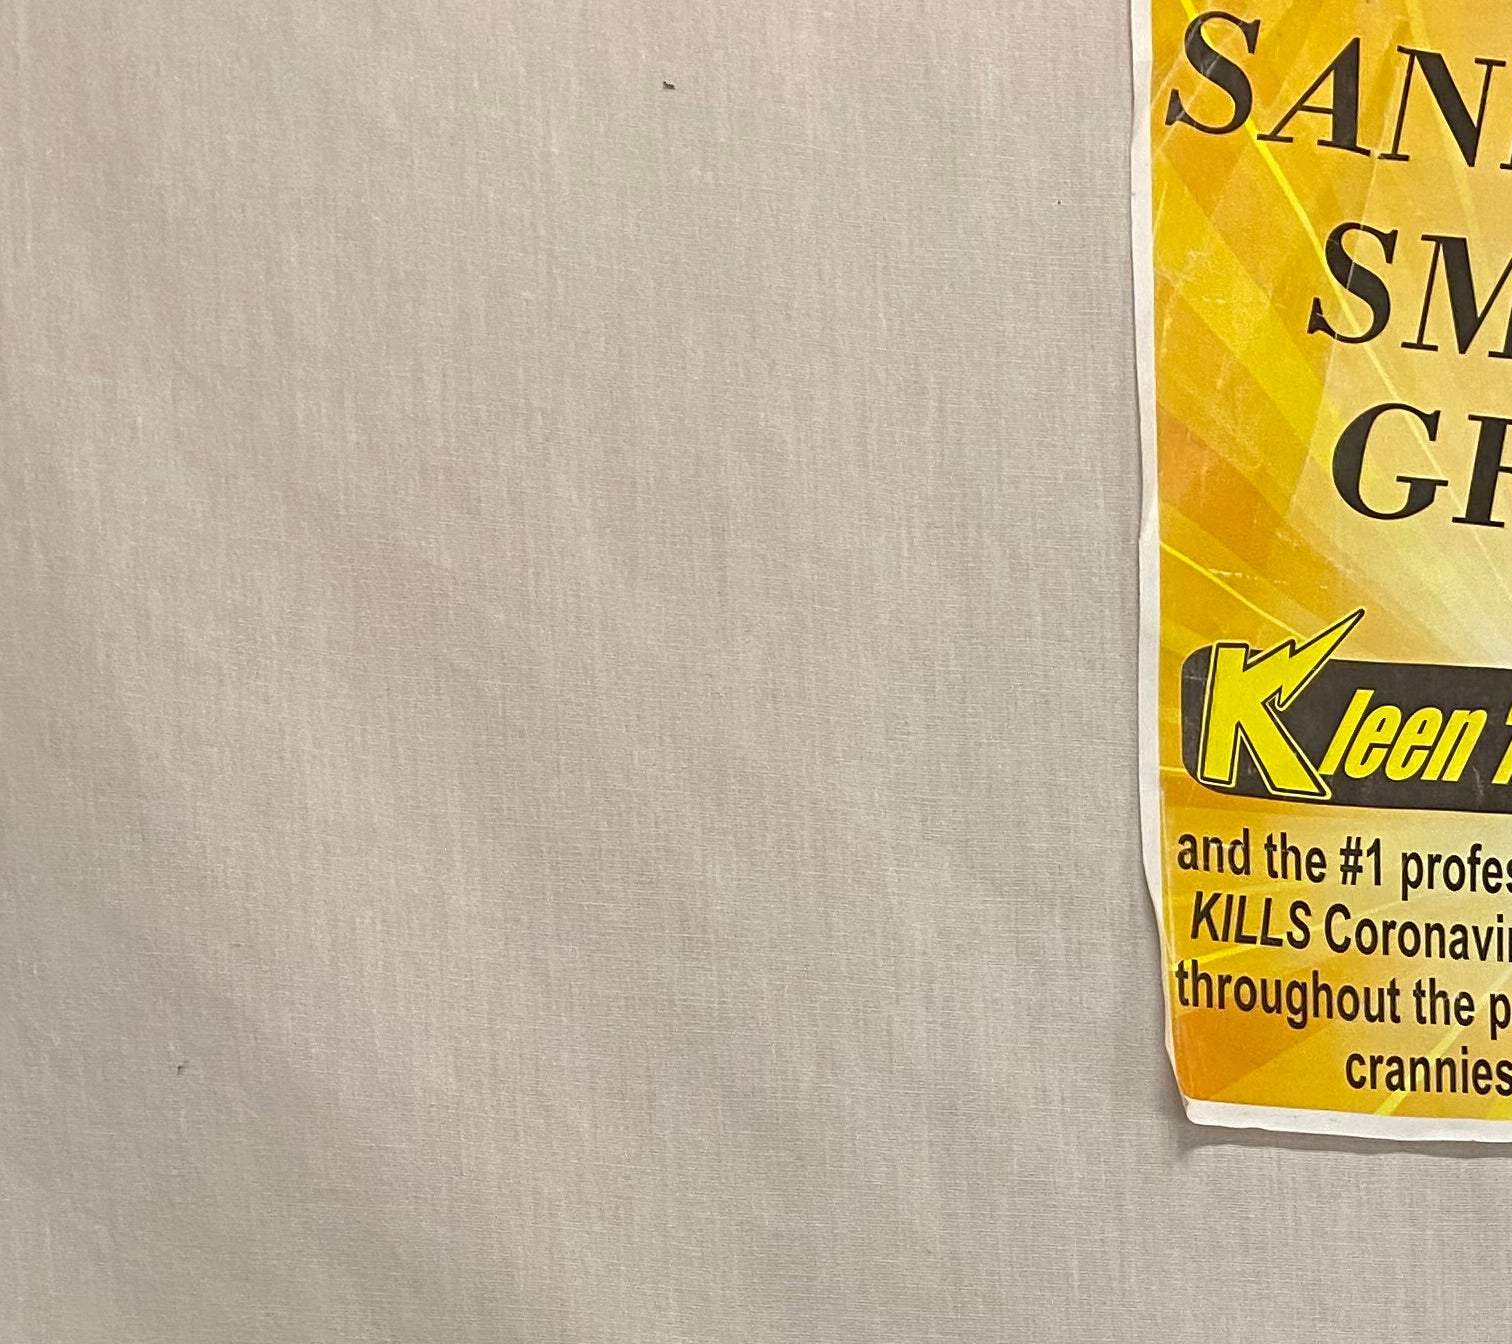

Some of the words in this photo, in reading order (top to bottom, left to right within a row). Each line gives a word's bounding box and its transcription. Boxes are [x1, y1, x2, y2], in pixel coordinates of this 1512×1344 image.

[1199, 606, 1488, 799] Kleen
[1177, 827, 1251, 876] and
[1264, 831, 1327, 884] the
[1339, 835, 1382, 886] #1
[1190, 891, 1312, 950] KILLS
[1175, 959, 1401, 1030] throughout
[1412, 977, 1475, 1027] the
